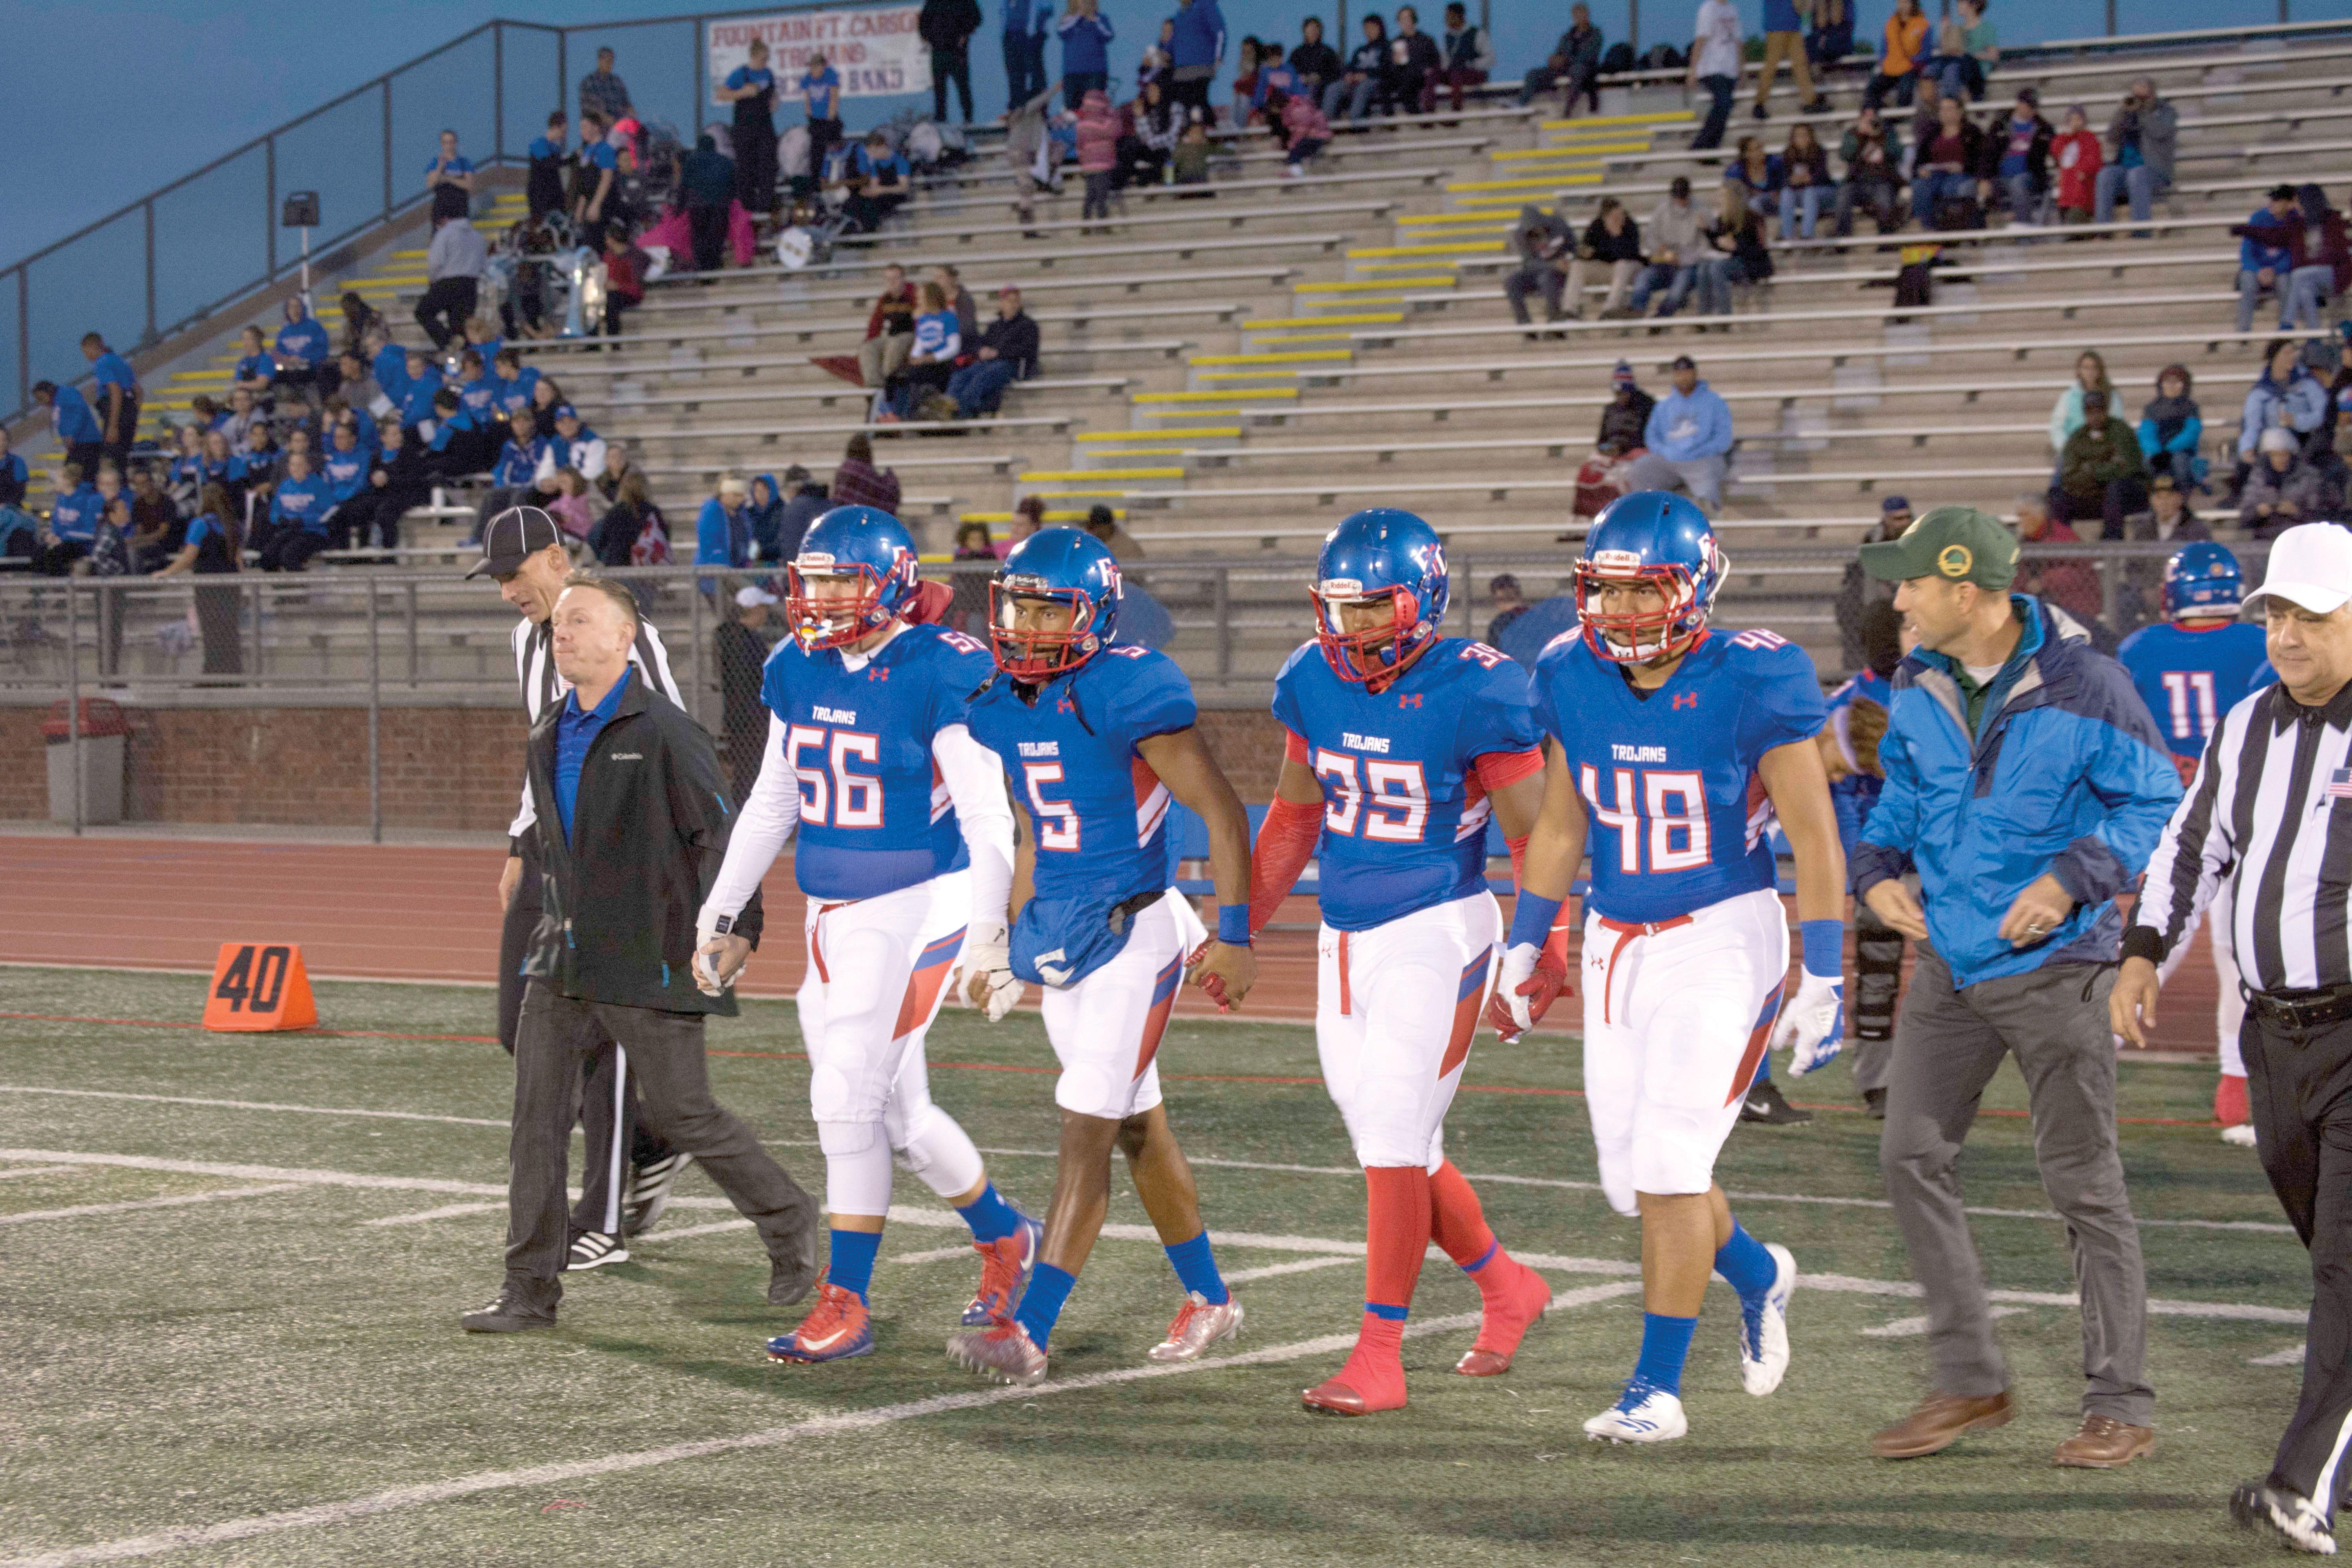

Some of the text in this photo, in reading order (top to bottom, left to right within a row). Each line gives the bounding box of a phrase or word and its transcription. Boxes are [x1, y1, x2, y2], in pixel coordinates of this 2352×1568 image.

[1108, 645, 1151, 659] 5
[813, 706, 856, 725] TROJANS
[2162, 671, 2217, 739] 11
[1018, 741, 1059, 757] TROJANS
[1342, 732, 1390, 753] TROJANS
[1611, 744, 1666, 762] TROJANS
[787, 724, 885, 829] 56
[1022, 761, 1081, 852] 5
[1316, 746, 1430, 842] 39
[1581, 762, 1713, 874] 48
[216, 946, 291, 1013] 40
